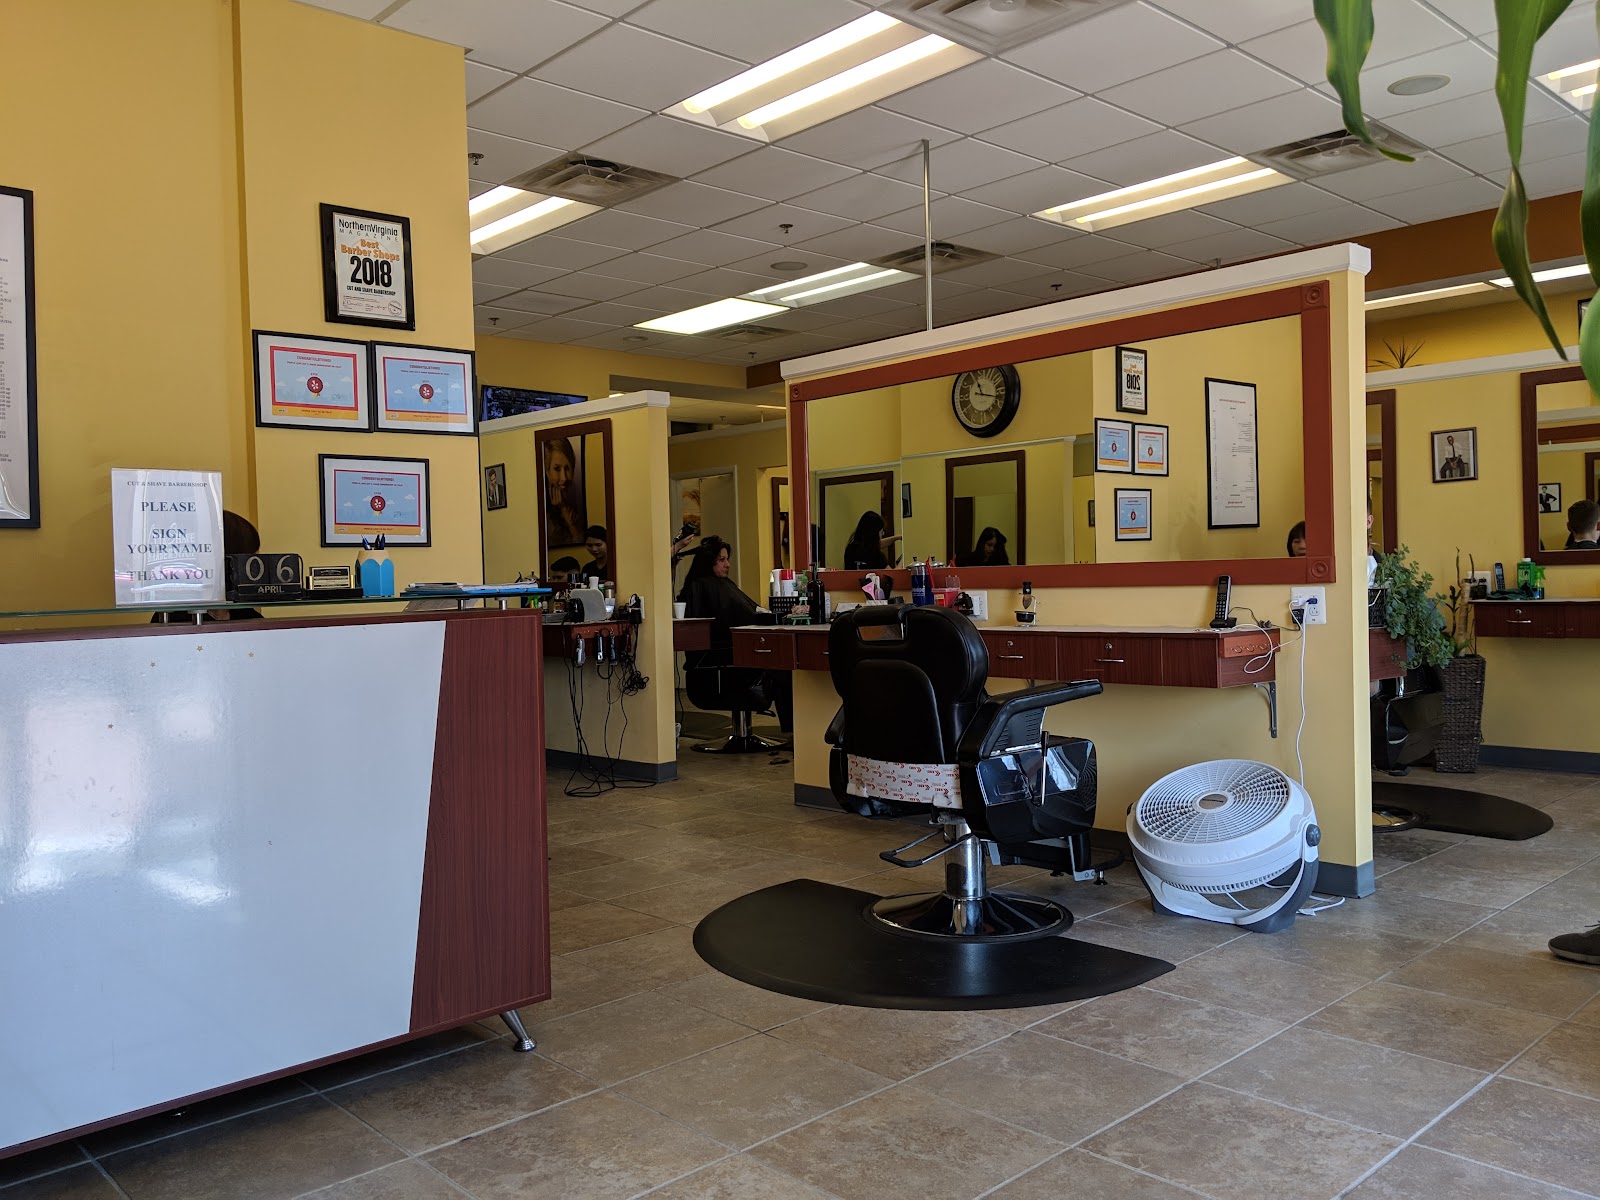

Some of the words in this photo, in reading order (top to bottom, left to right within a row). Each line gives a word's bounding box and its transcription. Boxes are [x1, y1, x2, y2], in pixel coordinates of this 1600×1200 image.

[340, 228, 399, 242] MAGAZINE
[360, 239, 379, 249] Best
[341, 244, 372, 256] Barber
[373, 249, 400, 262] Shops
[350, 255, 392, 287] 2018
[141, 502, 196, 512] PLEASE
[152, 528, 187, 539] SIGN
[127, 544, 168, 554] YOUR
[171, 544, 212, 553] NAME
[126, 570, 181, 580] THANK
[184, 569, 214, 580] YOU
[258, 585, 284, 594] APRIL
